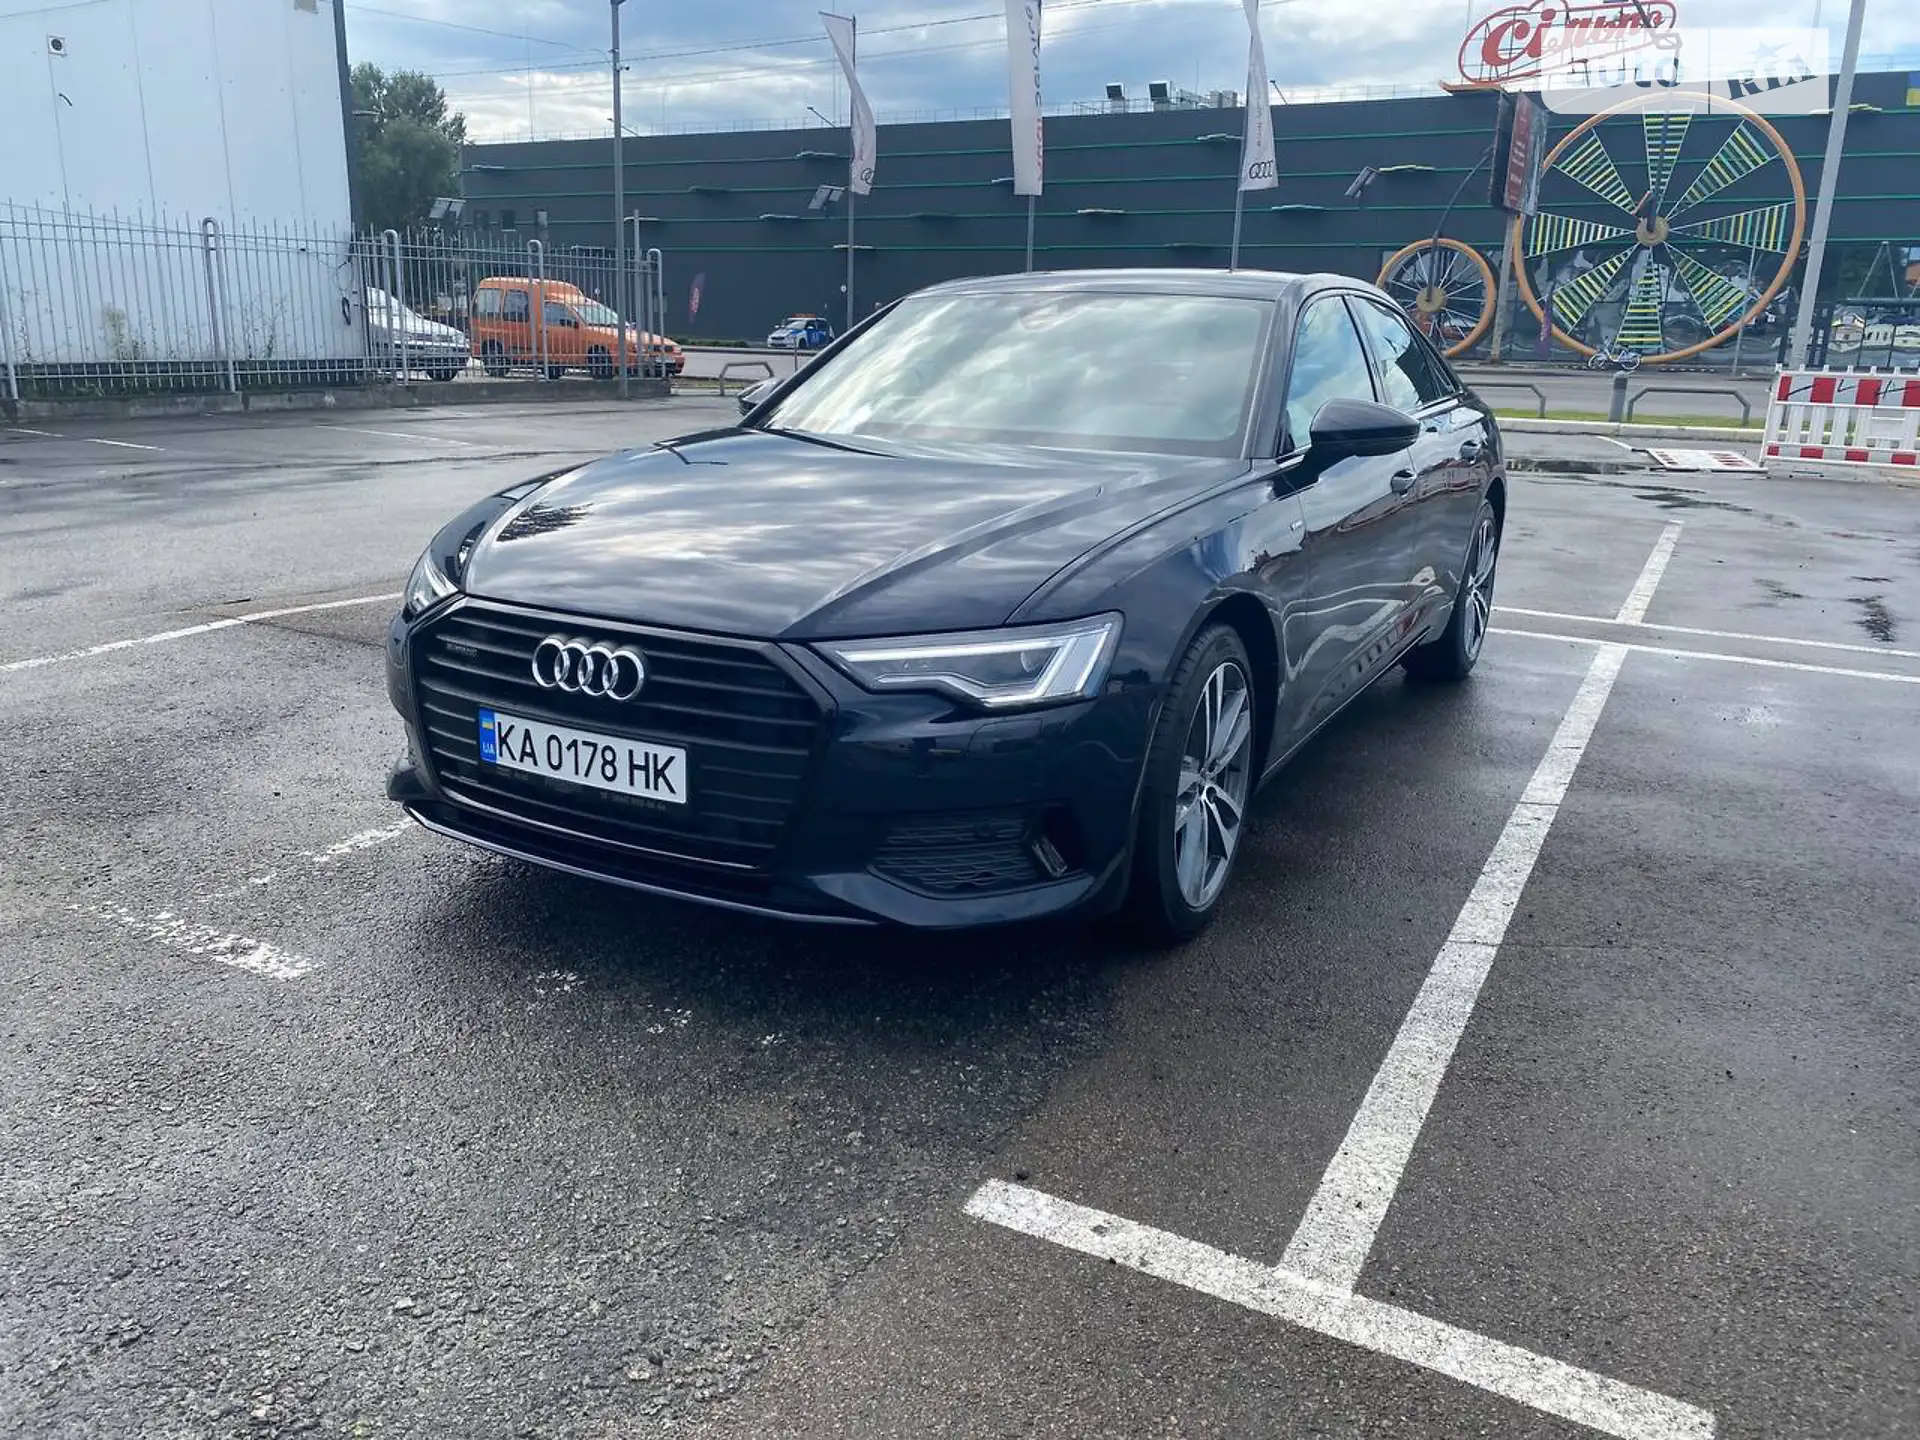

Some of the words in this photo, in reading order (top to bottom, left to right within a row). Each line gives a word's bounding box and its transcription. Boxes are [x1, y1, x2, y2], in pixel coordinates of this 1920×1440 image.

[482, 740, 496, 755] UA
[497, 721, 539, 767] KA
[546, 734, 618, 782] 0178
[628, 749, 677, 795] HK
